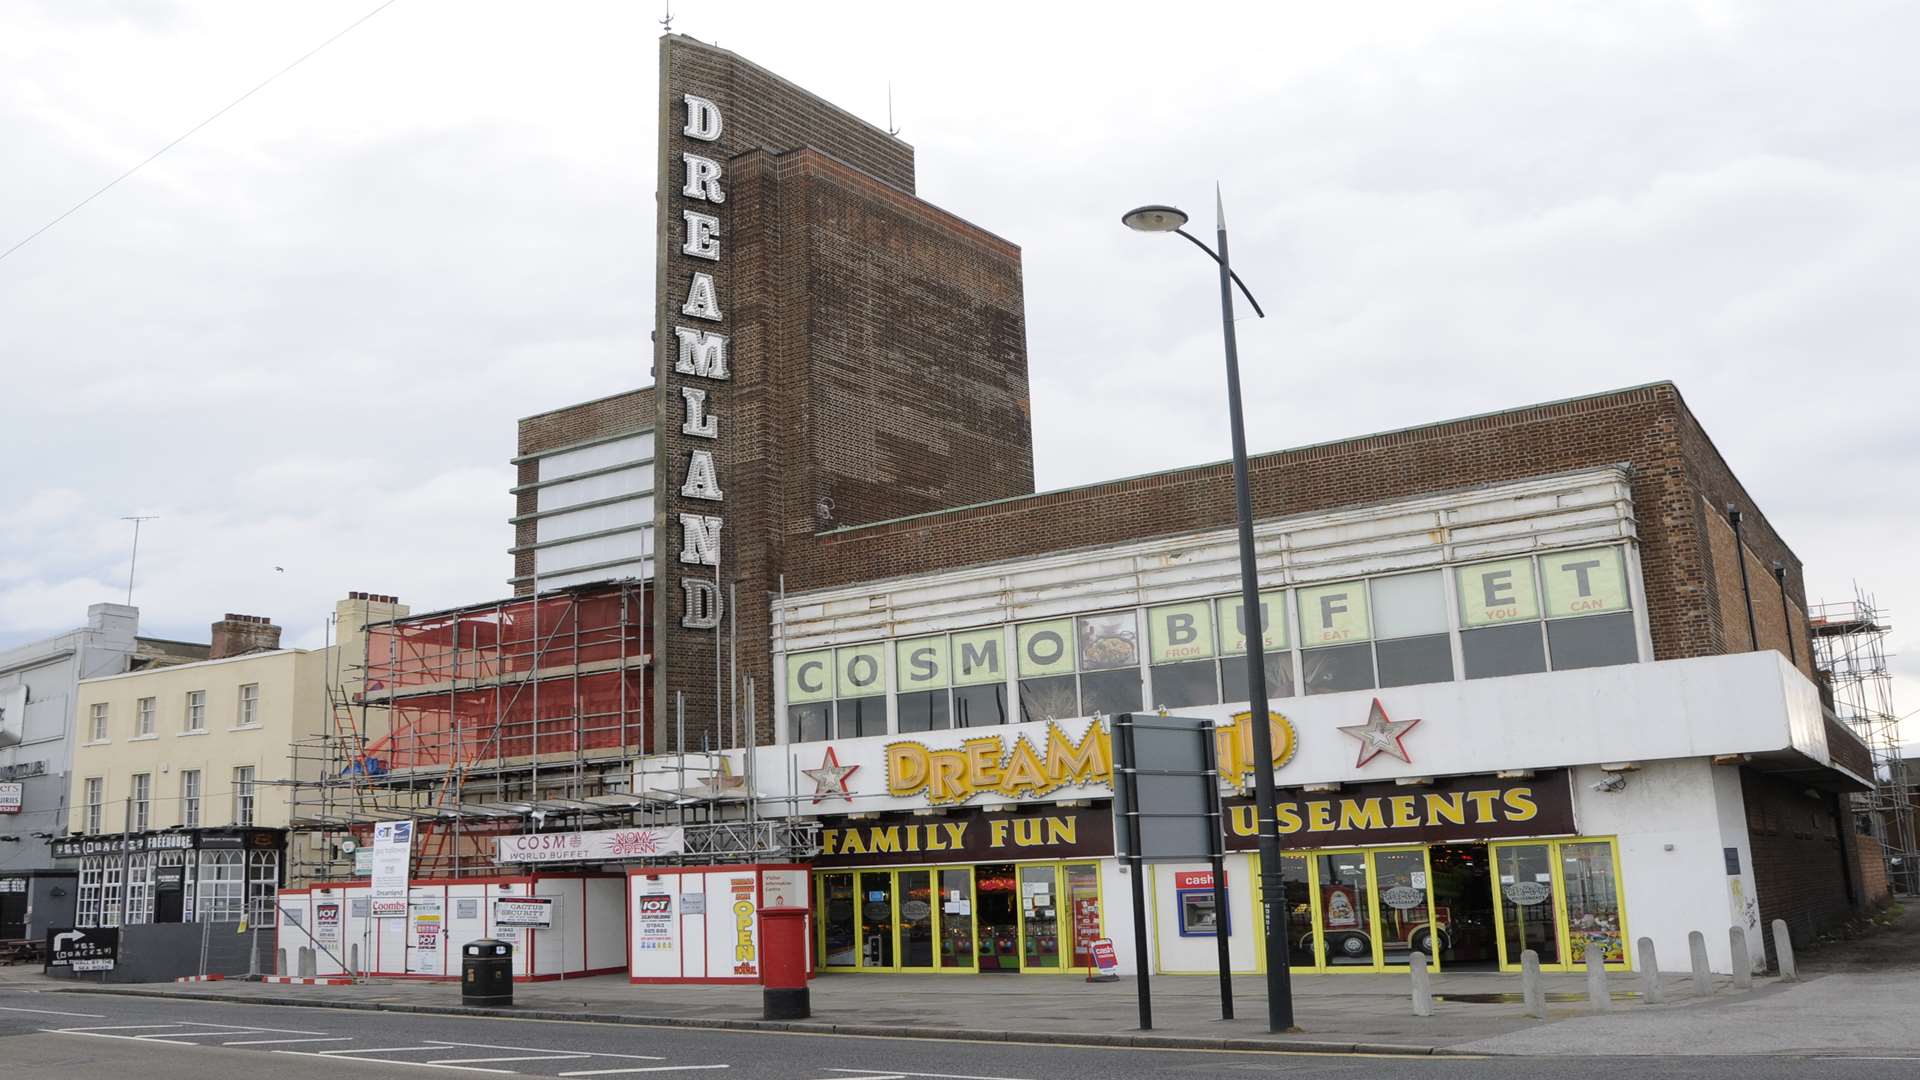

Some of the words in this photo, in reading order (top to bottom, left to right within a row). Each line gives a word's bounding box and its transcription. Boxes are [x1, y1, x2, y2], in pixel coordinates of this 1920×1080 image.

[675, 94, 730, 629] DREAMLAND
[1570, 600, 1603, 612] CAN
[1486, 607, 1517, 620] YOU
[1323, 630, 1351, 641] EAT
[1165, 646, 1200, 658] FROM
[797, 631, 1064, 693] COSMO
[1222, 787, 1538, 837] USEMENTS
[615, 831, 652, 844] NOW
[822, 821, 968, 855] FAMILY
[989, 815, 1077, 848] FUN
[612, 842, 656, 854] OPEN
[510, 852, 546, 860] WORLD
[550, 850, 589, 859] BUFFET
[1185, 874, 1214, 885] cash
[372, 901, 405, 910] Coombs
[733, 900, 755, 961] OPEN
[1096, 946, 1113, 955] cash
